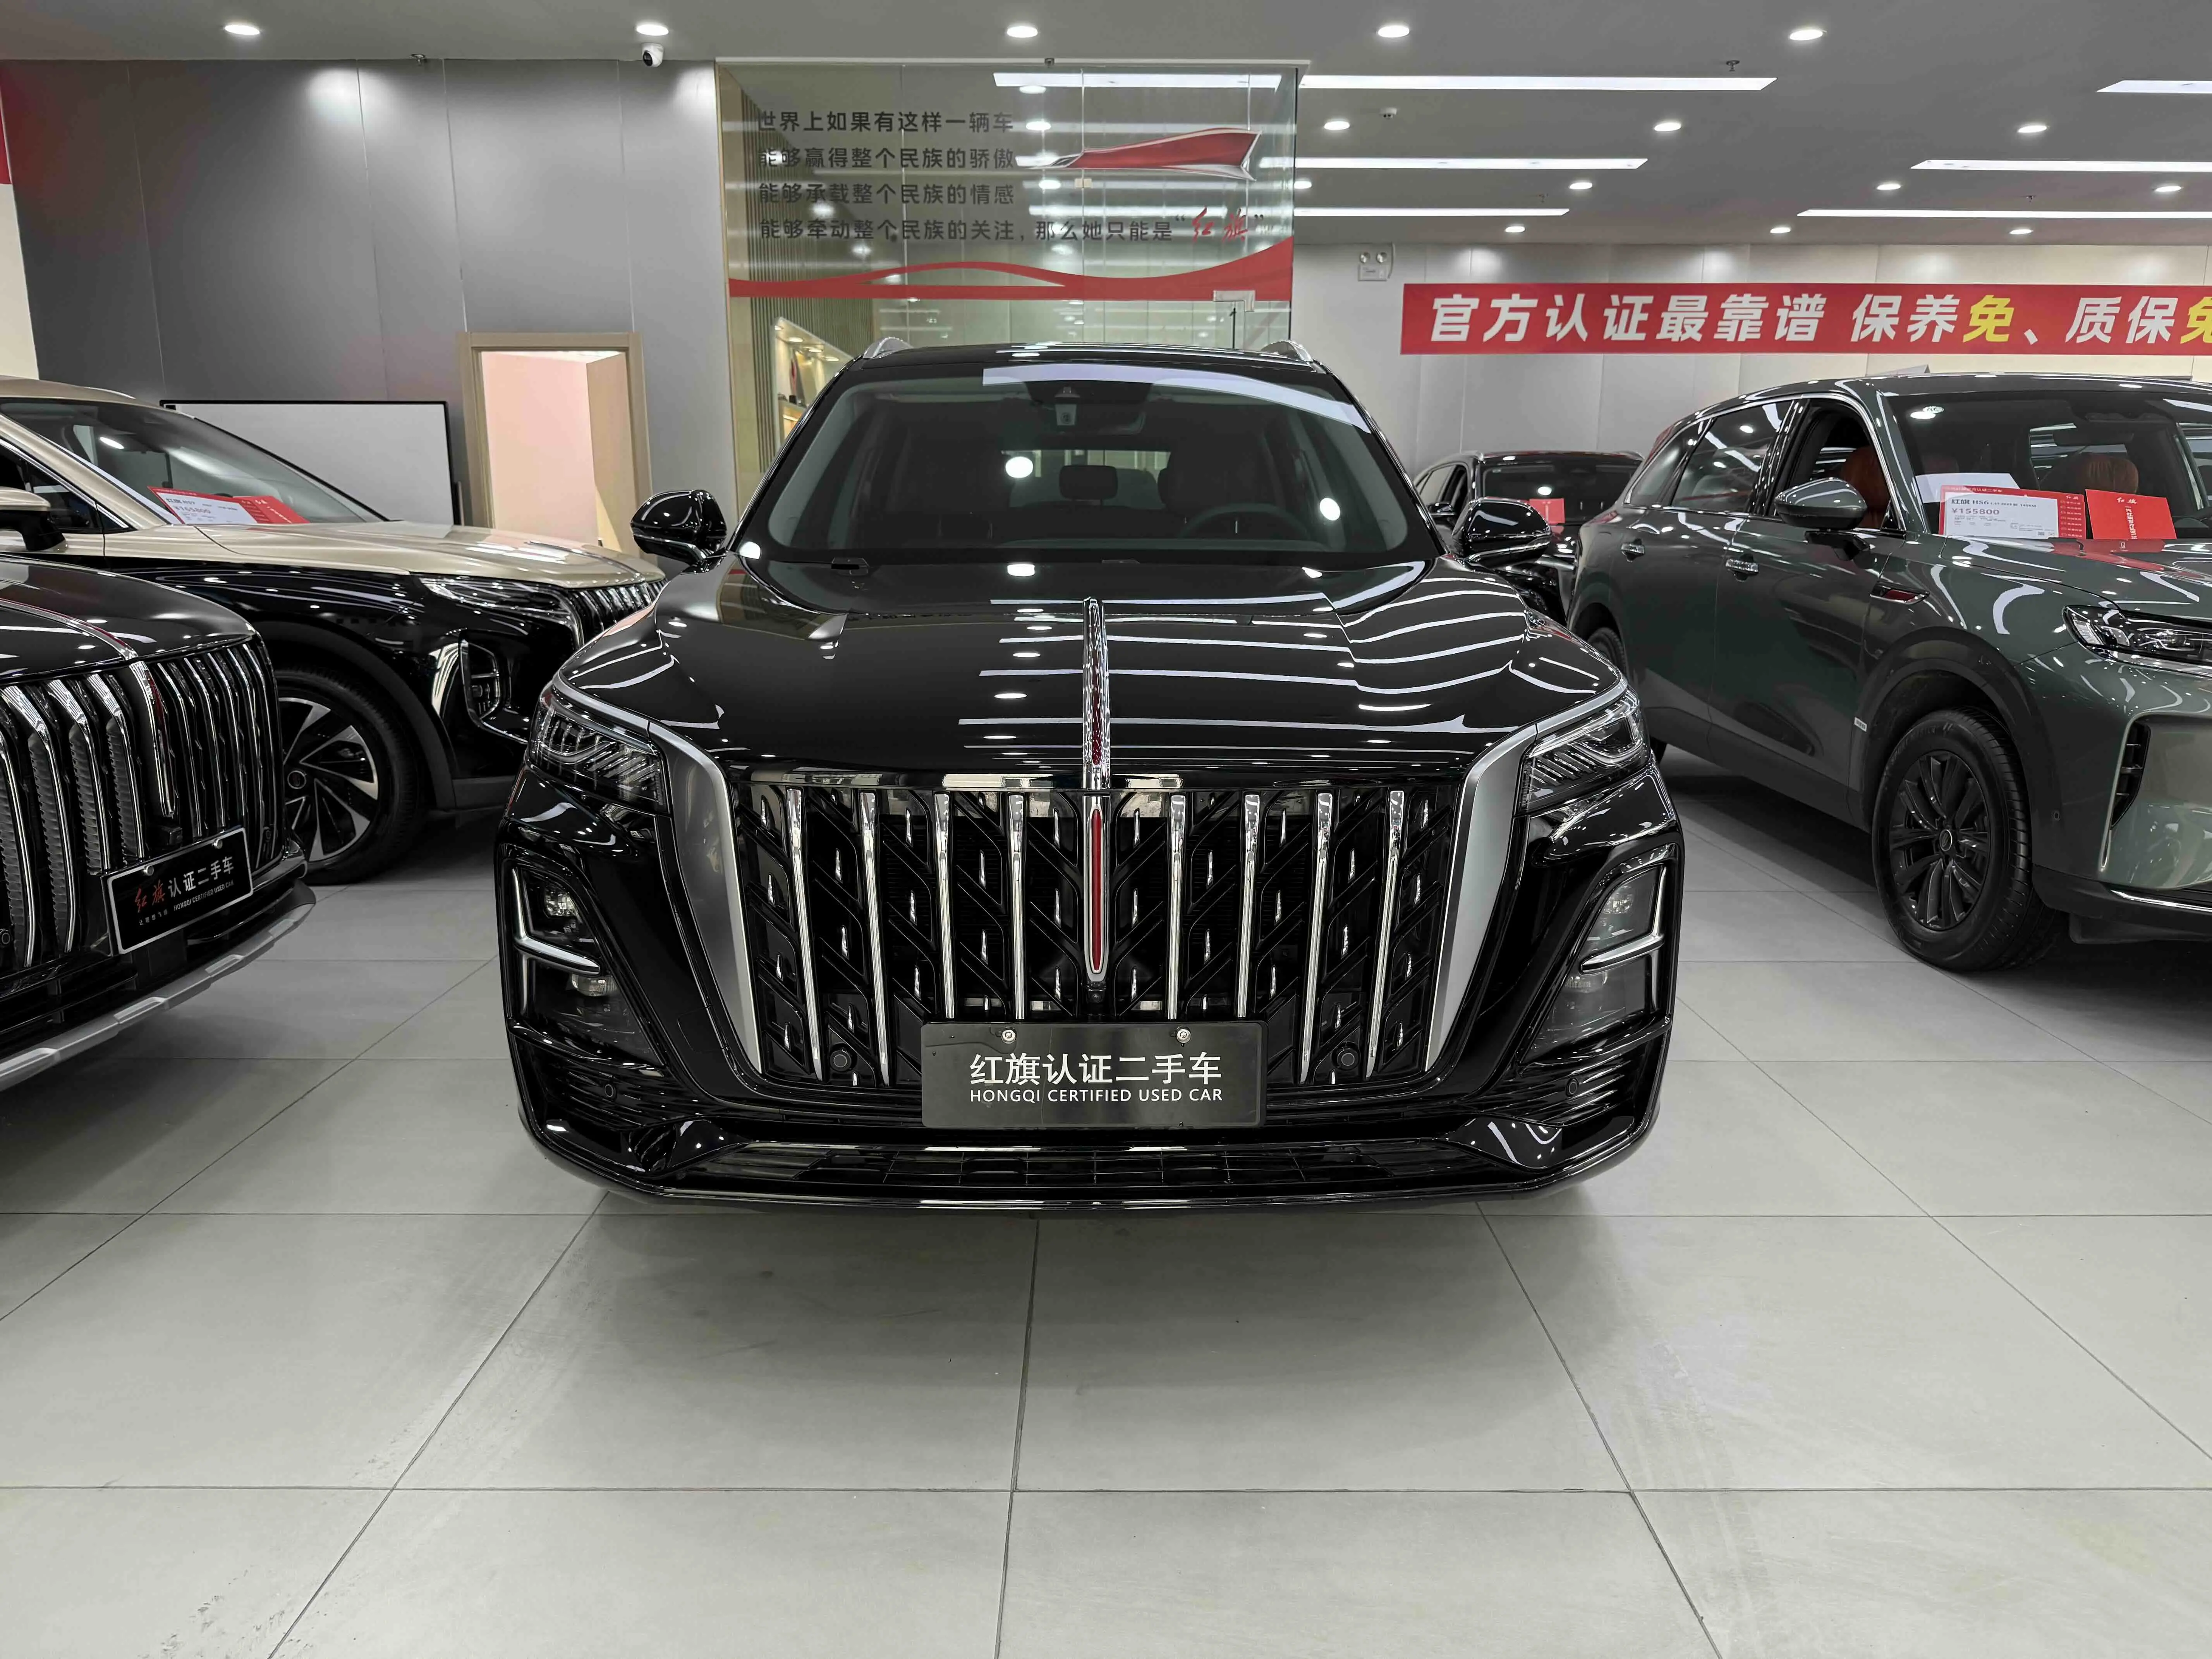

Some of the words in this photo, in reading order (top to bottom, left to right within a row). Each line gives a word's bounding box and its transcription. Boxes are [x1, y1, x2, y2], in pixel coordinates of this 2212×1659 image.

[758, 111, 1014, 133] 世界上如果有这样一辆车
[759, 148, 1014, 169] 能够赢得整个民族的骄傲
[759, 184, 1014, 204] 能够承载整个民族的情感
[1431, 293, 1827, 342] 官方认证最靠谱
[135, 856, 234, 913] 红旗认证二手车
[173, 899, 191, 911] HONGQI
[192, 889, 214, 903] CERTIFIED
[214, 884, 225, 893] USED
[970, 1052, 1222, 1085] 红旗认证二手车
[970, 1089, 1040, 1102] HONGQI
[1048, 1089, 1132, 1102] CERTIFIED
[1139, 1089, 1182, 1102] USED
[1189, 1089, 1223, 1102] CAR
